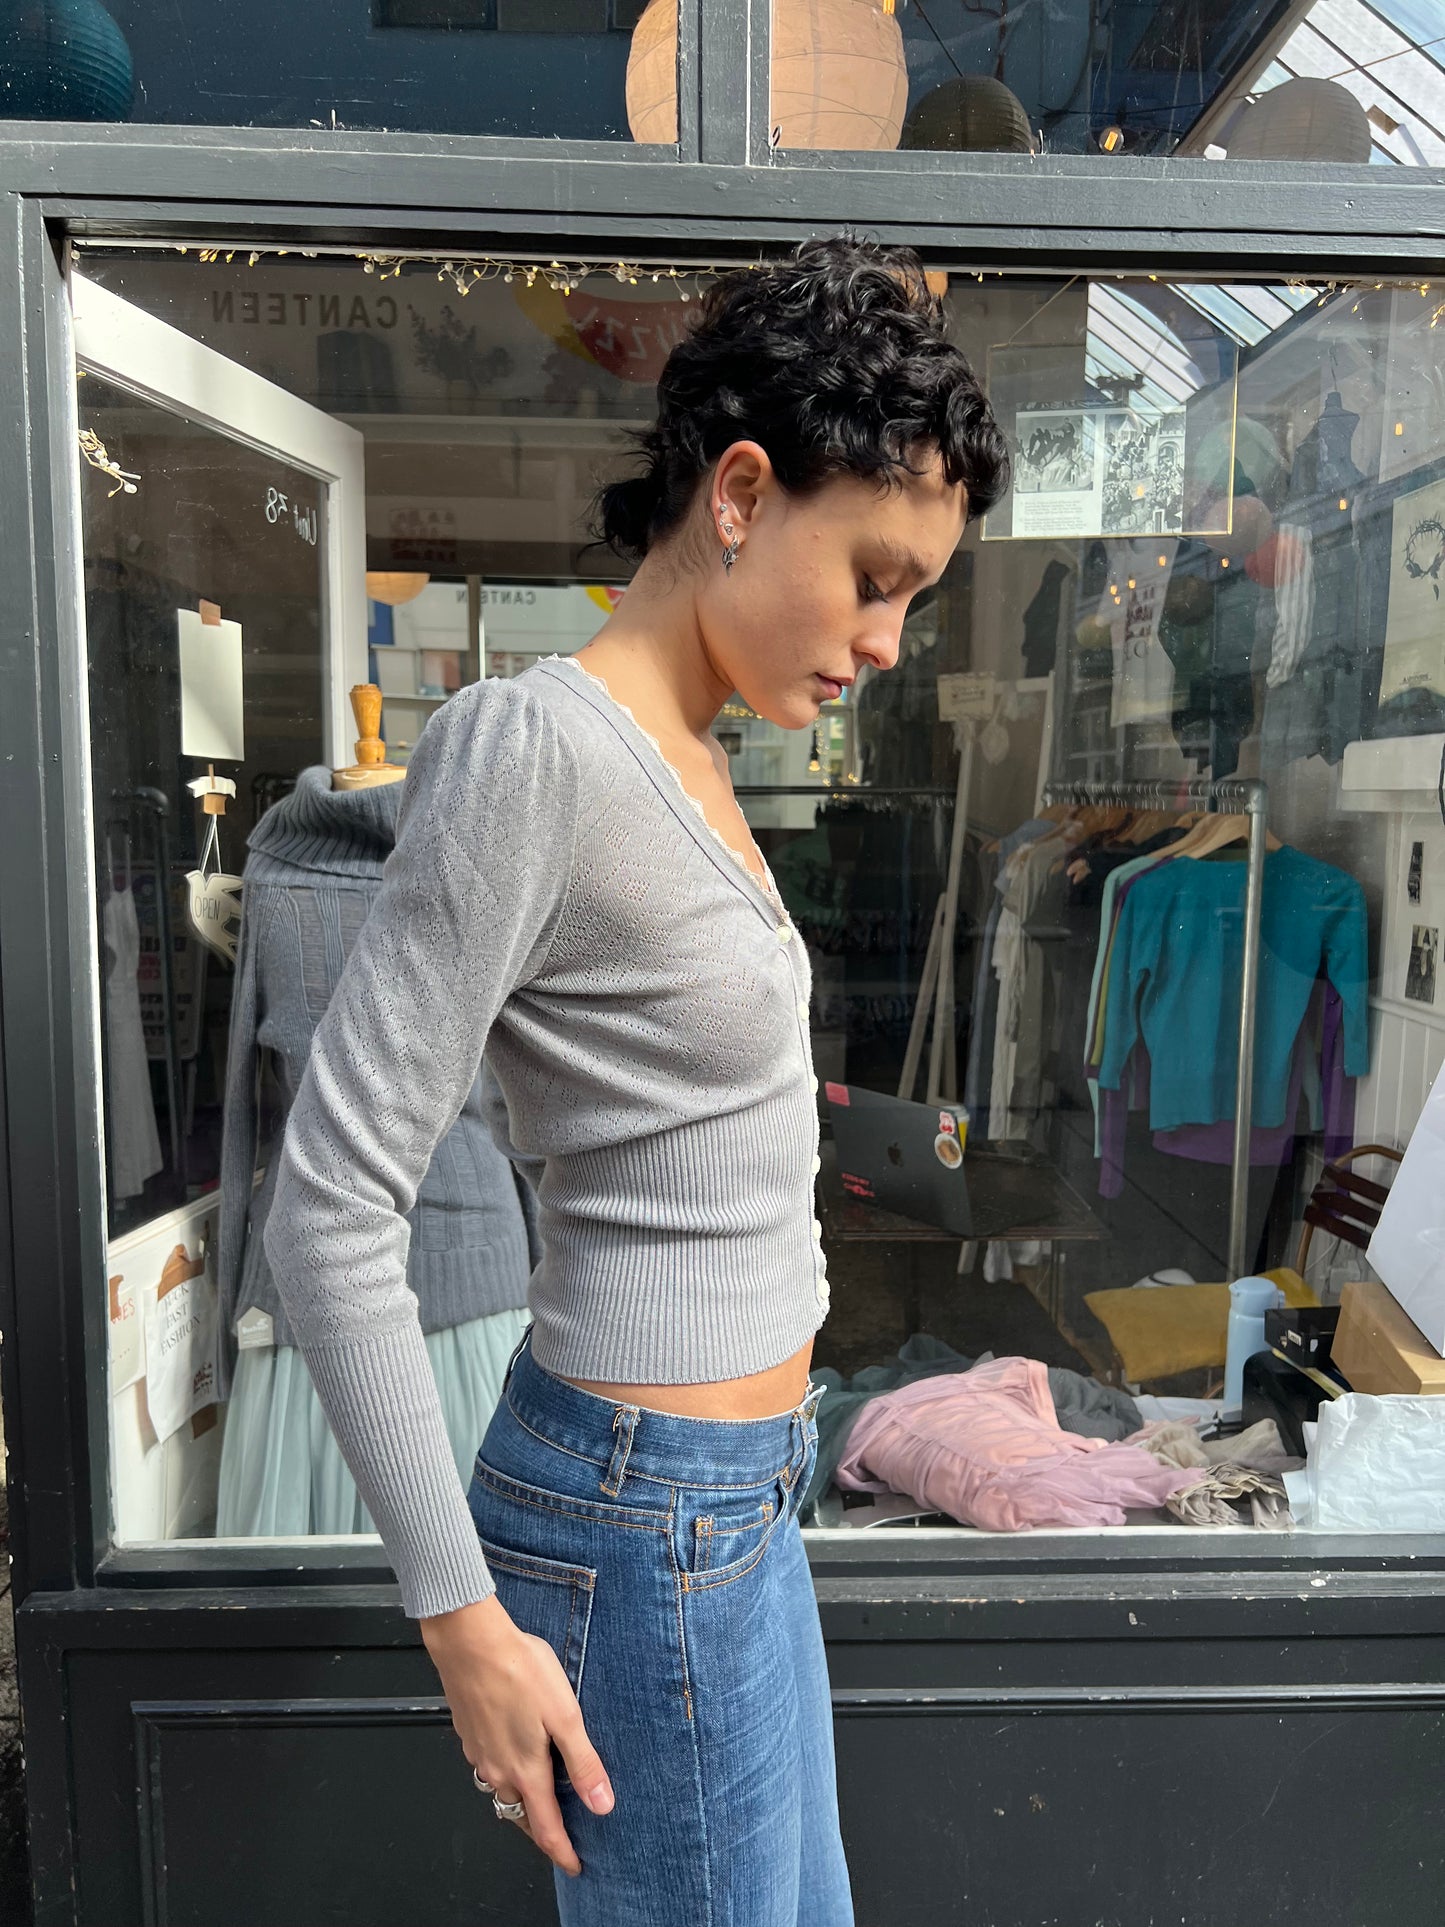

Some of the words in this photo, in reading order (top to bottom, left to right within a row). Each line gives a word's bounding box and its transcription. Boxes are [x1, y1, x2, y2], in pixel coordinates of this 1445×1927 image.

[194, 896, 221, 921] OPEN
[167, 1302, 188, 1328] FAST
[160, 1312, 201, 1356] FASHION
